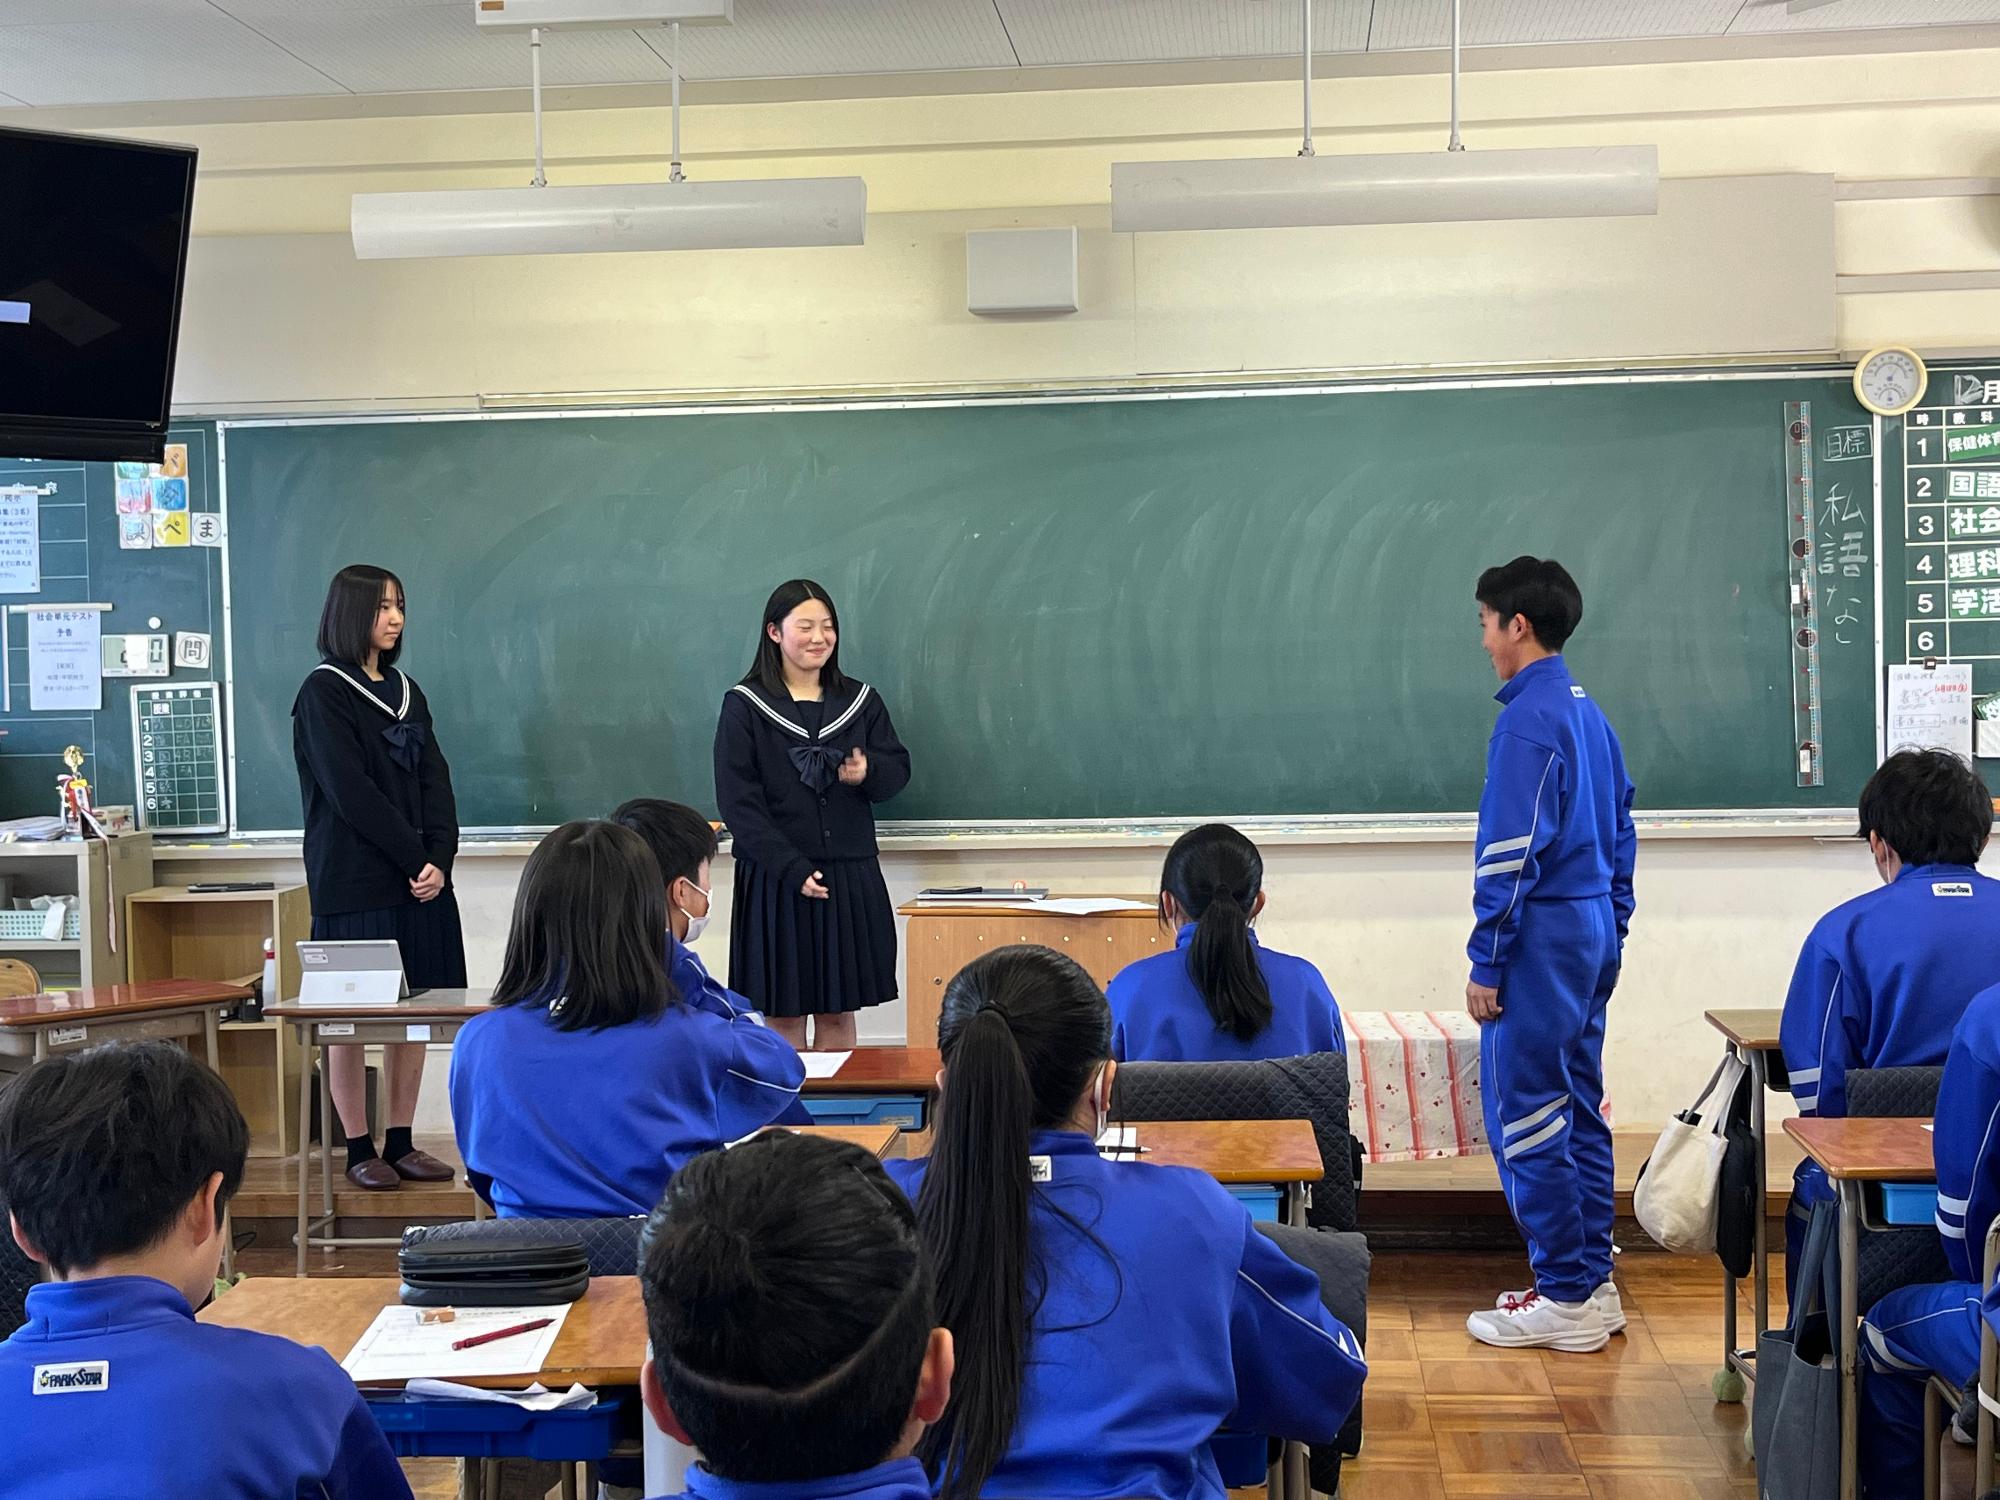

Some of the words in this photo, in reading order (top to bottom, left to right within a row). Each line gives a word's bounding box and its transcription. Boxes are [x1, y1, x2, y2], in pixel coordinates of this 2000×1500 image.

[1827, 430, 1866, 459] 目標
[1916, 438, 1928, 457] 1
[1916, 478, 1932, 497] 2
[1949, 471, 2000, 498] 国語
[199, 519, 213, 538] ま
[1918, 515, 1934, 535] 3
[1950, 507, 2000, 535] 社会
[1818, 482, 1868, 644] 私語なし
[1916, 555, 1933, 574] 4
[1948, 548, 2000, 578] 理科
[1917, 593, 1934, 613] 5
[1951, 588, 2000, 616] 学活
[184, 640, 202, 660] 問
[1917, 631, 1934, 651] 6
[143, 719, 150, 732] 1
[143, 734, 153, 747] 2
[144, 750, 154, 763] 3
[145, 766, 155, 778] 4
[146, 781, 156, 794] 5
[147, 797, 157, 810] 6
